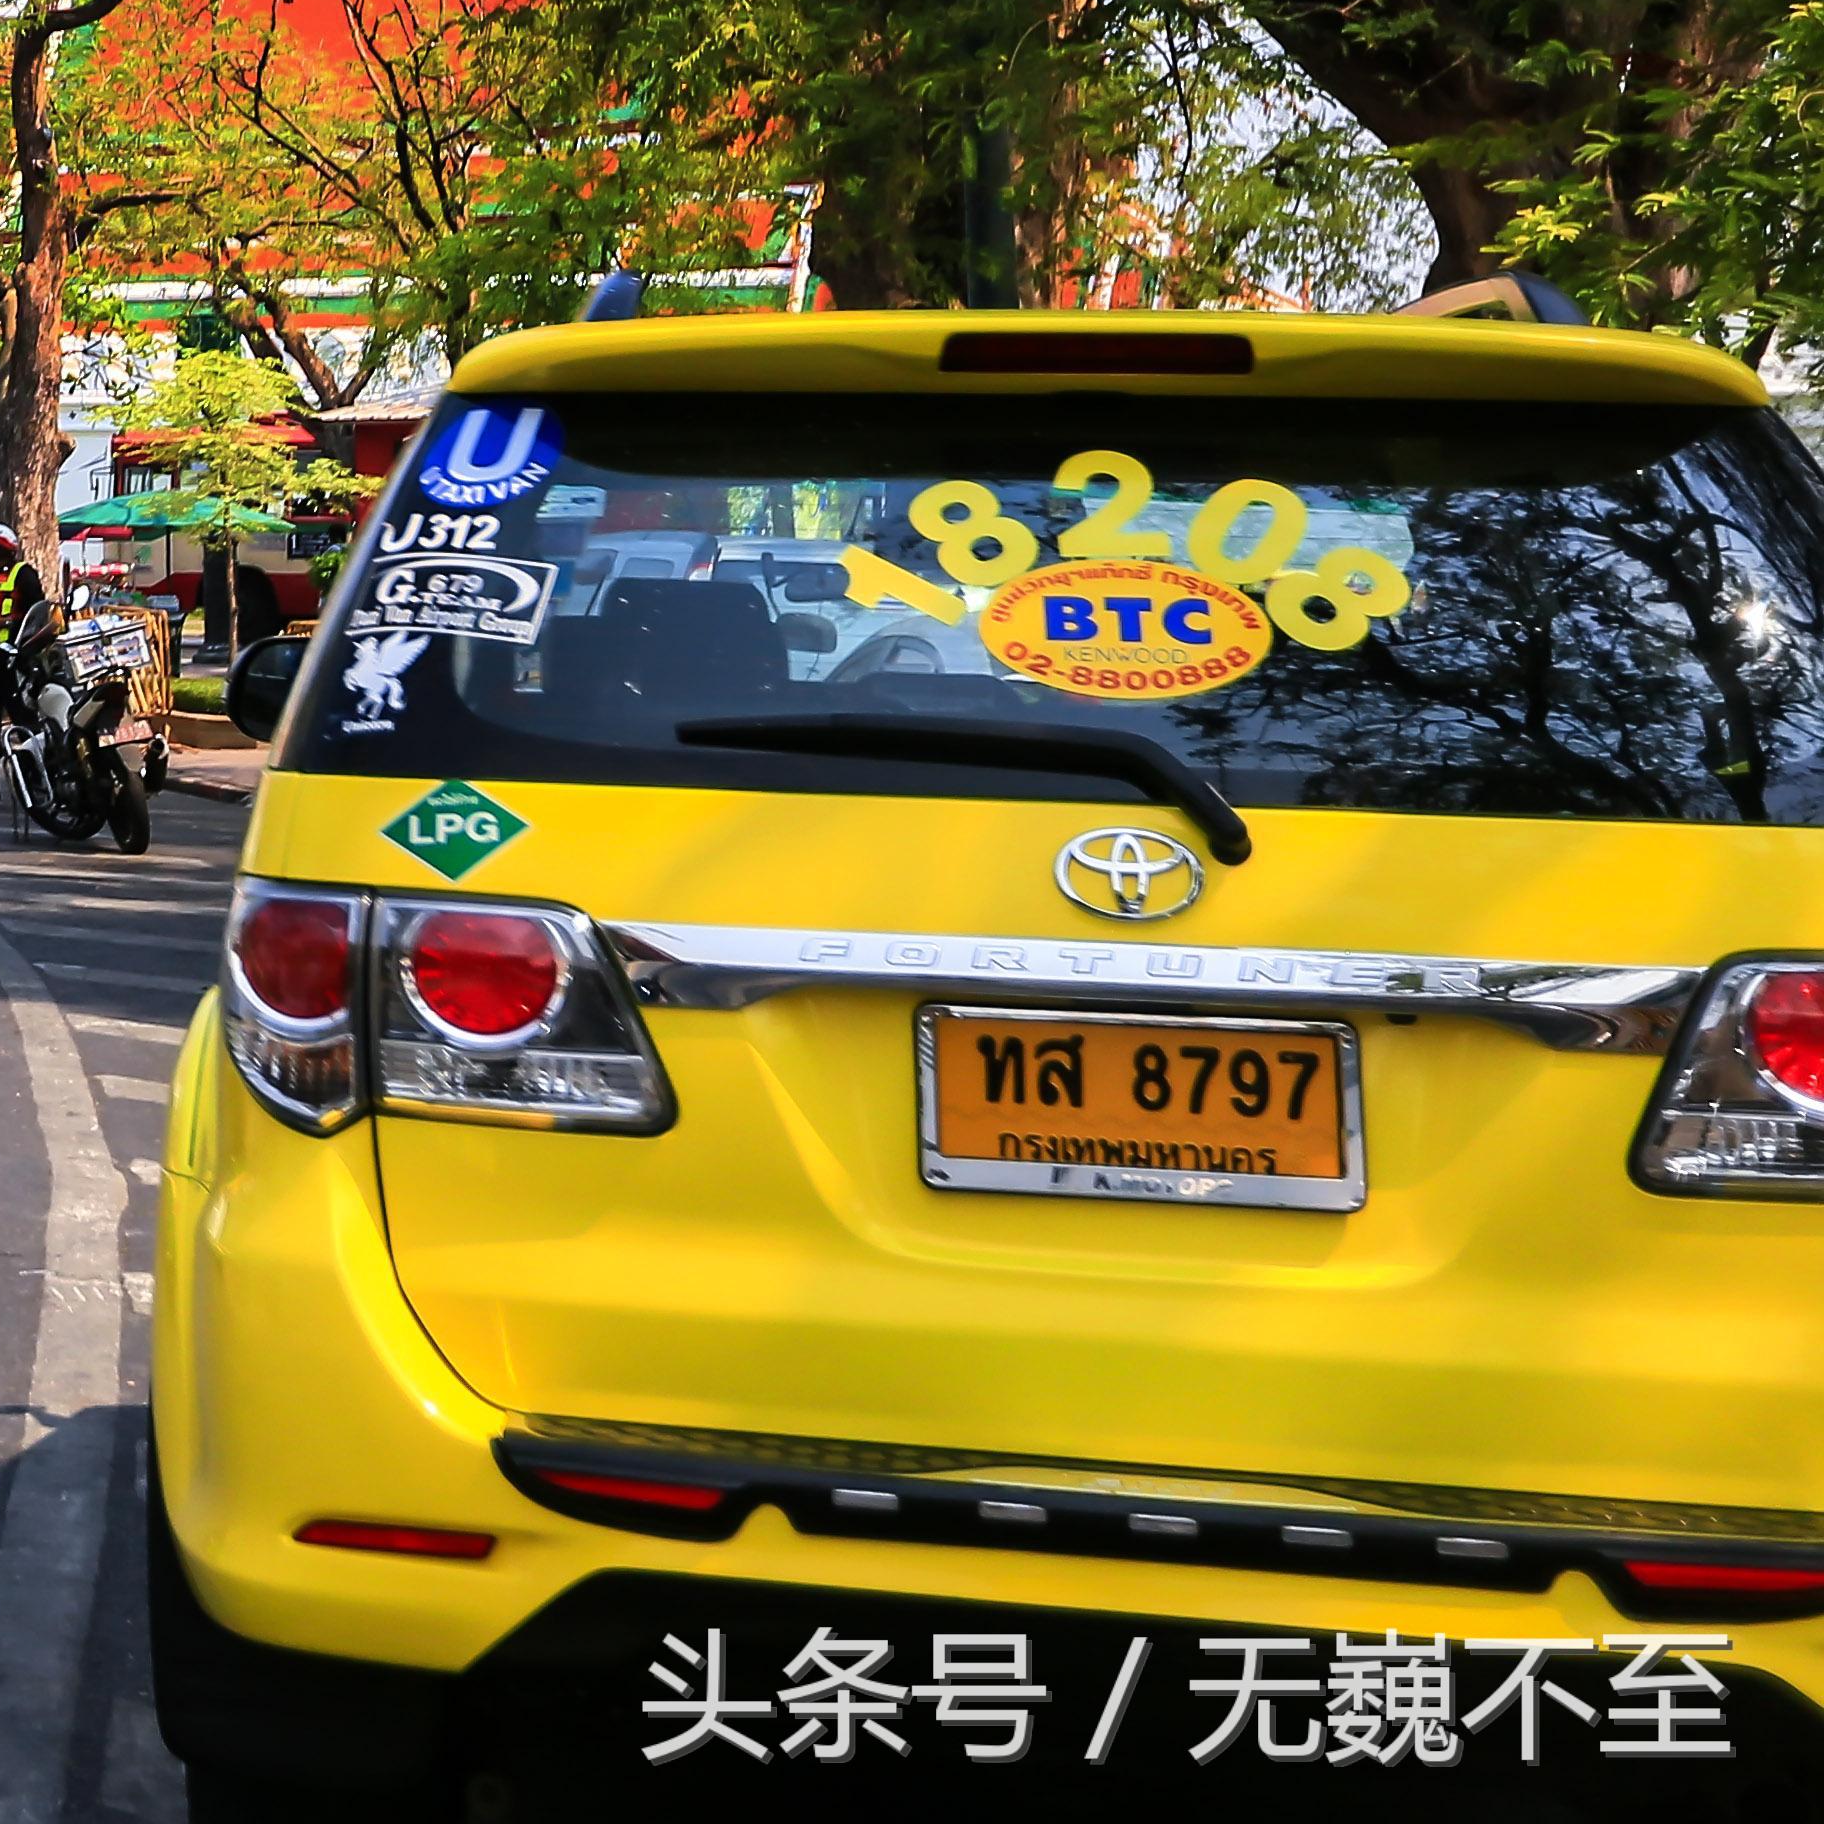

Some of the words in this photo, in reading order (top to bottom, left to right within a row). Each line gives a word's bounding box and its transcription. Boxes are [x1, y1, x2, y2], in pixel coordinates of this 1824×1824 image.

[447, 408, 544, 482] U
[486, 462, 550, 500] VAN
[380, 513, 501, 552] U312
[838, 450, 1412, 651] 18208
[1043, 596, 1213, 645] BTC
[1004, 641, 1252, 691] 02-8800888
[1064, 646, 1189, 665] KENWOOD
[408, 811, 501, 845] LPG
[798, 936, 1487, 994] FORTUNER
[976, 1033, 1085, 1108] ทส
[1132, 1043, 1320, 1121] 8797
[997, 1130, 1278, 1175] กรงเทพมหานคร
